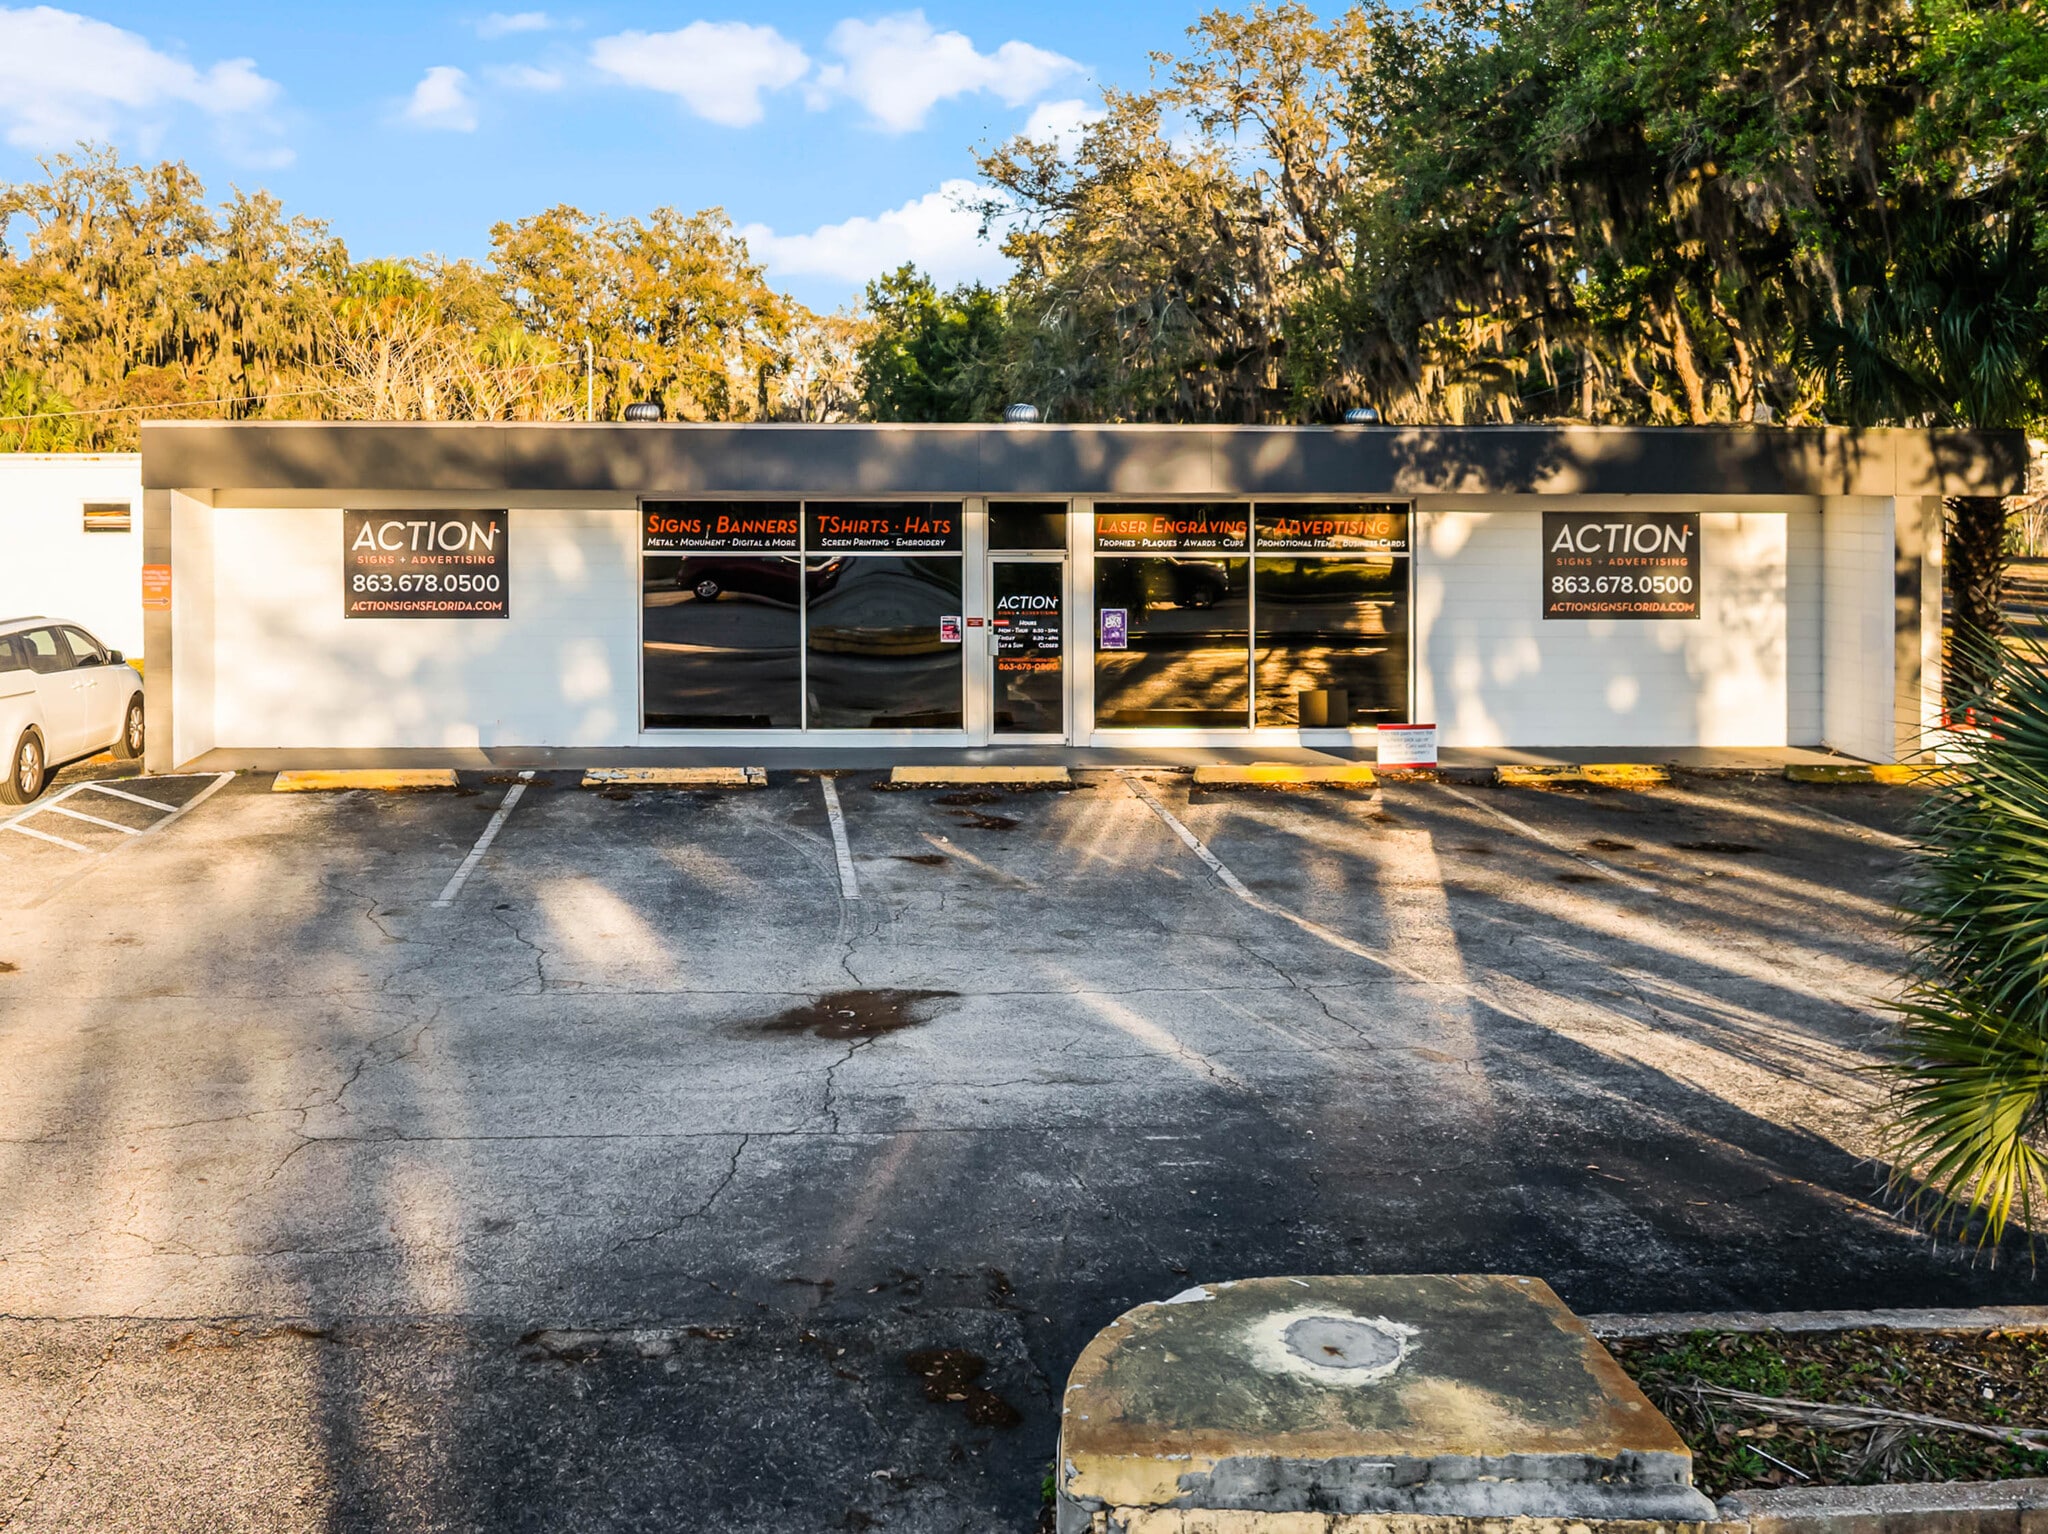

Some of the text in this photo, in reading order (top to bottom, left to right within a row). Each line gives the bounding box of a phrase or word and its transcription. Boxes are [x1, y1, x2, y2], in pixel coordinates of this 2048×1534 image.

[352, 521, 498, 551] ACTION
[1551, 523, 1690, 553] ACTION
[357, 555, 395, 564] SIGNS
[411, 555, 496, 564] ADVERTISING
[1556, 557, 1593, 566] SIGNS
[1608, 557, 1689, 566] ADVERTISING
[352, 574, 500, 592] 863.678.0500
[1551, 576, 1693, 594] 863.678.0500
[351, 601, 503, 611] ACTIONSIGNSFLORIDA.COM
[997, 595, 1058, 609] ACTION
[1550, 602, 1695, 612] ACTIONSIGNSFLORIDA.COM
